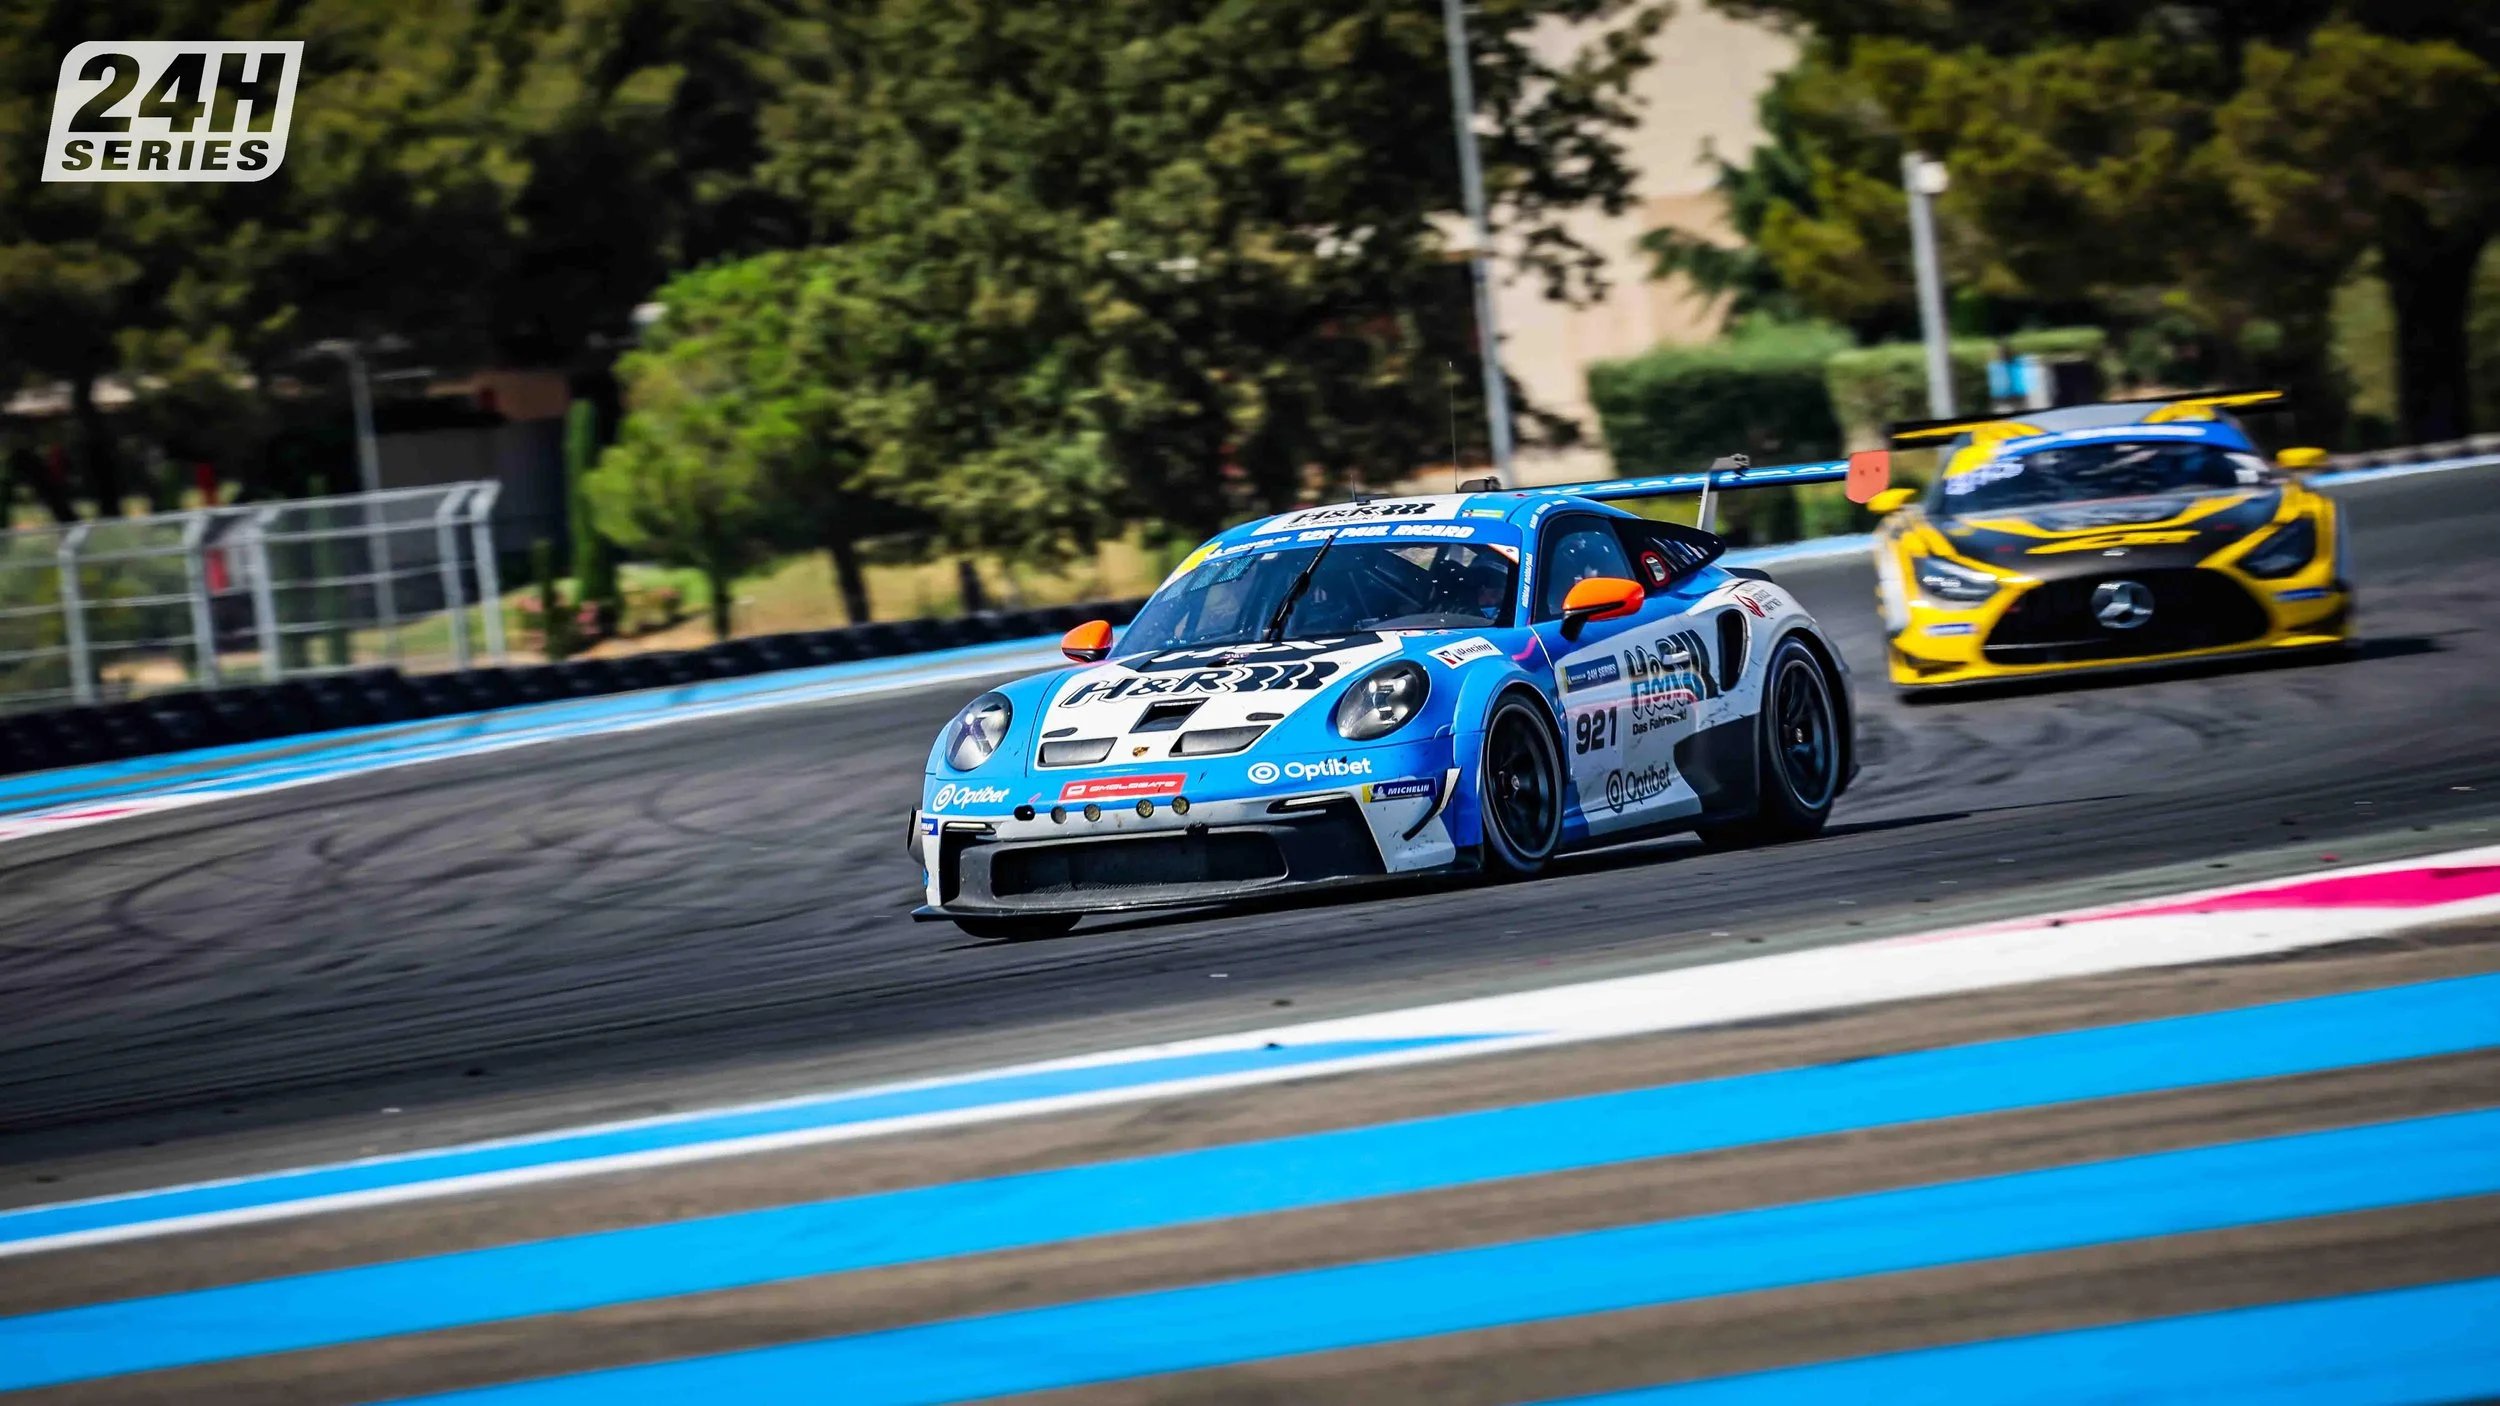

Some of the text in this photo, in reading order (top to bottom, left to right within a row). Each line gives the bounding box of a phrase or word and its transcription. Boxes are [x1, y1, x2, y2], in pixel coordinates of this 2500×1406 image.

[1335, 525, 1391, 540] PAUL
[1391, 524, 1476, 540] RICARD
[1598, 663, 1617, 678] SERIES
[1058, 667, 1248, 708] H&R
[1575, 706, 1618, 755] 921
[1632, 721, 1649, 736] Das
[1283, 757, 1373, 782] Optibet
[1387, 784, 1430, 796] MICHELIN
[1626, 761, 1672, 805] Optibet
[953, 785, 1011, 807] Optibet
